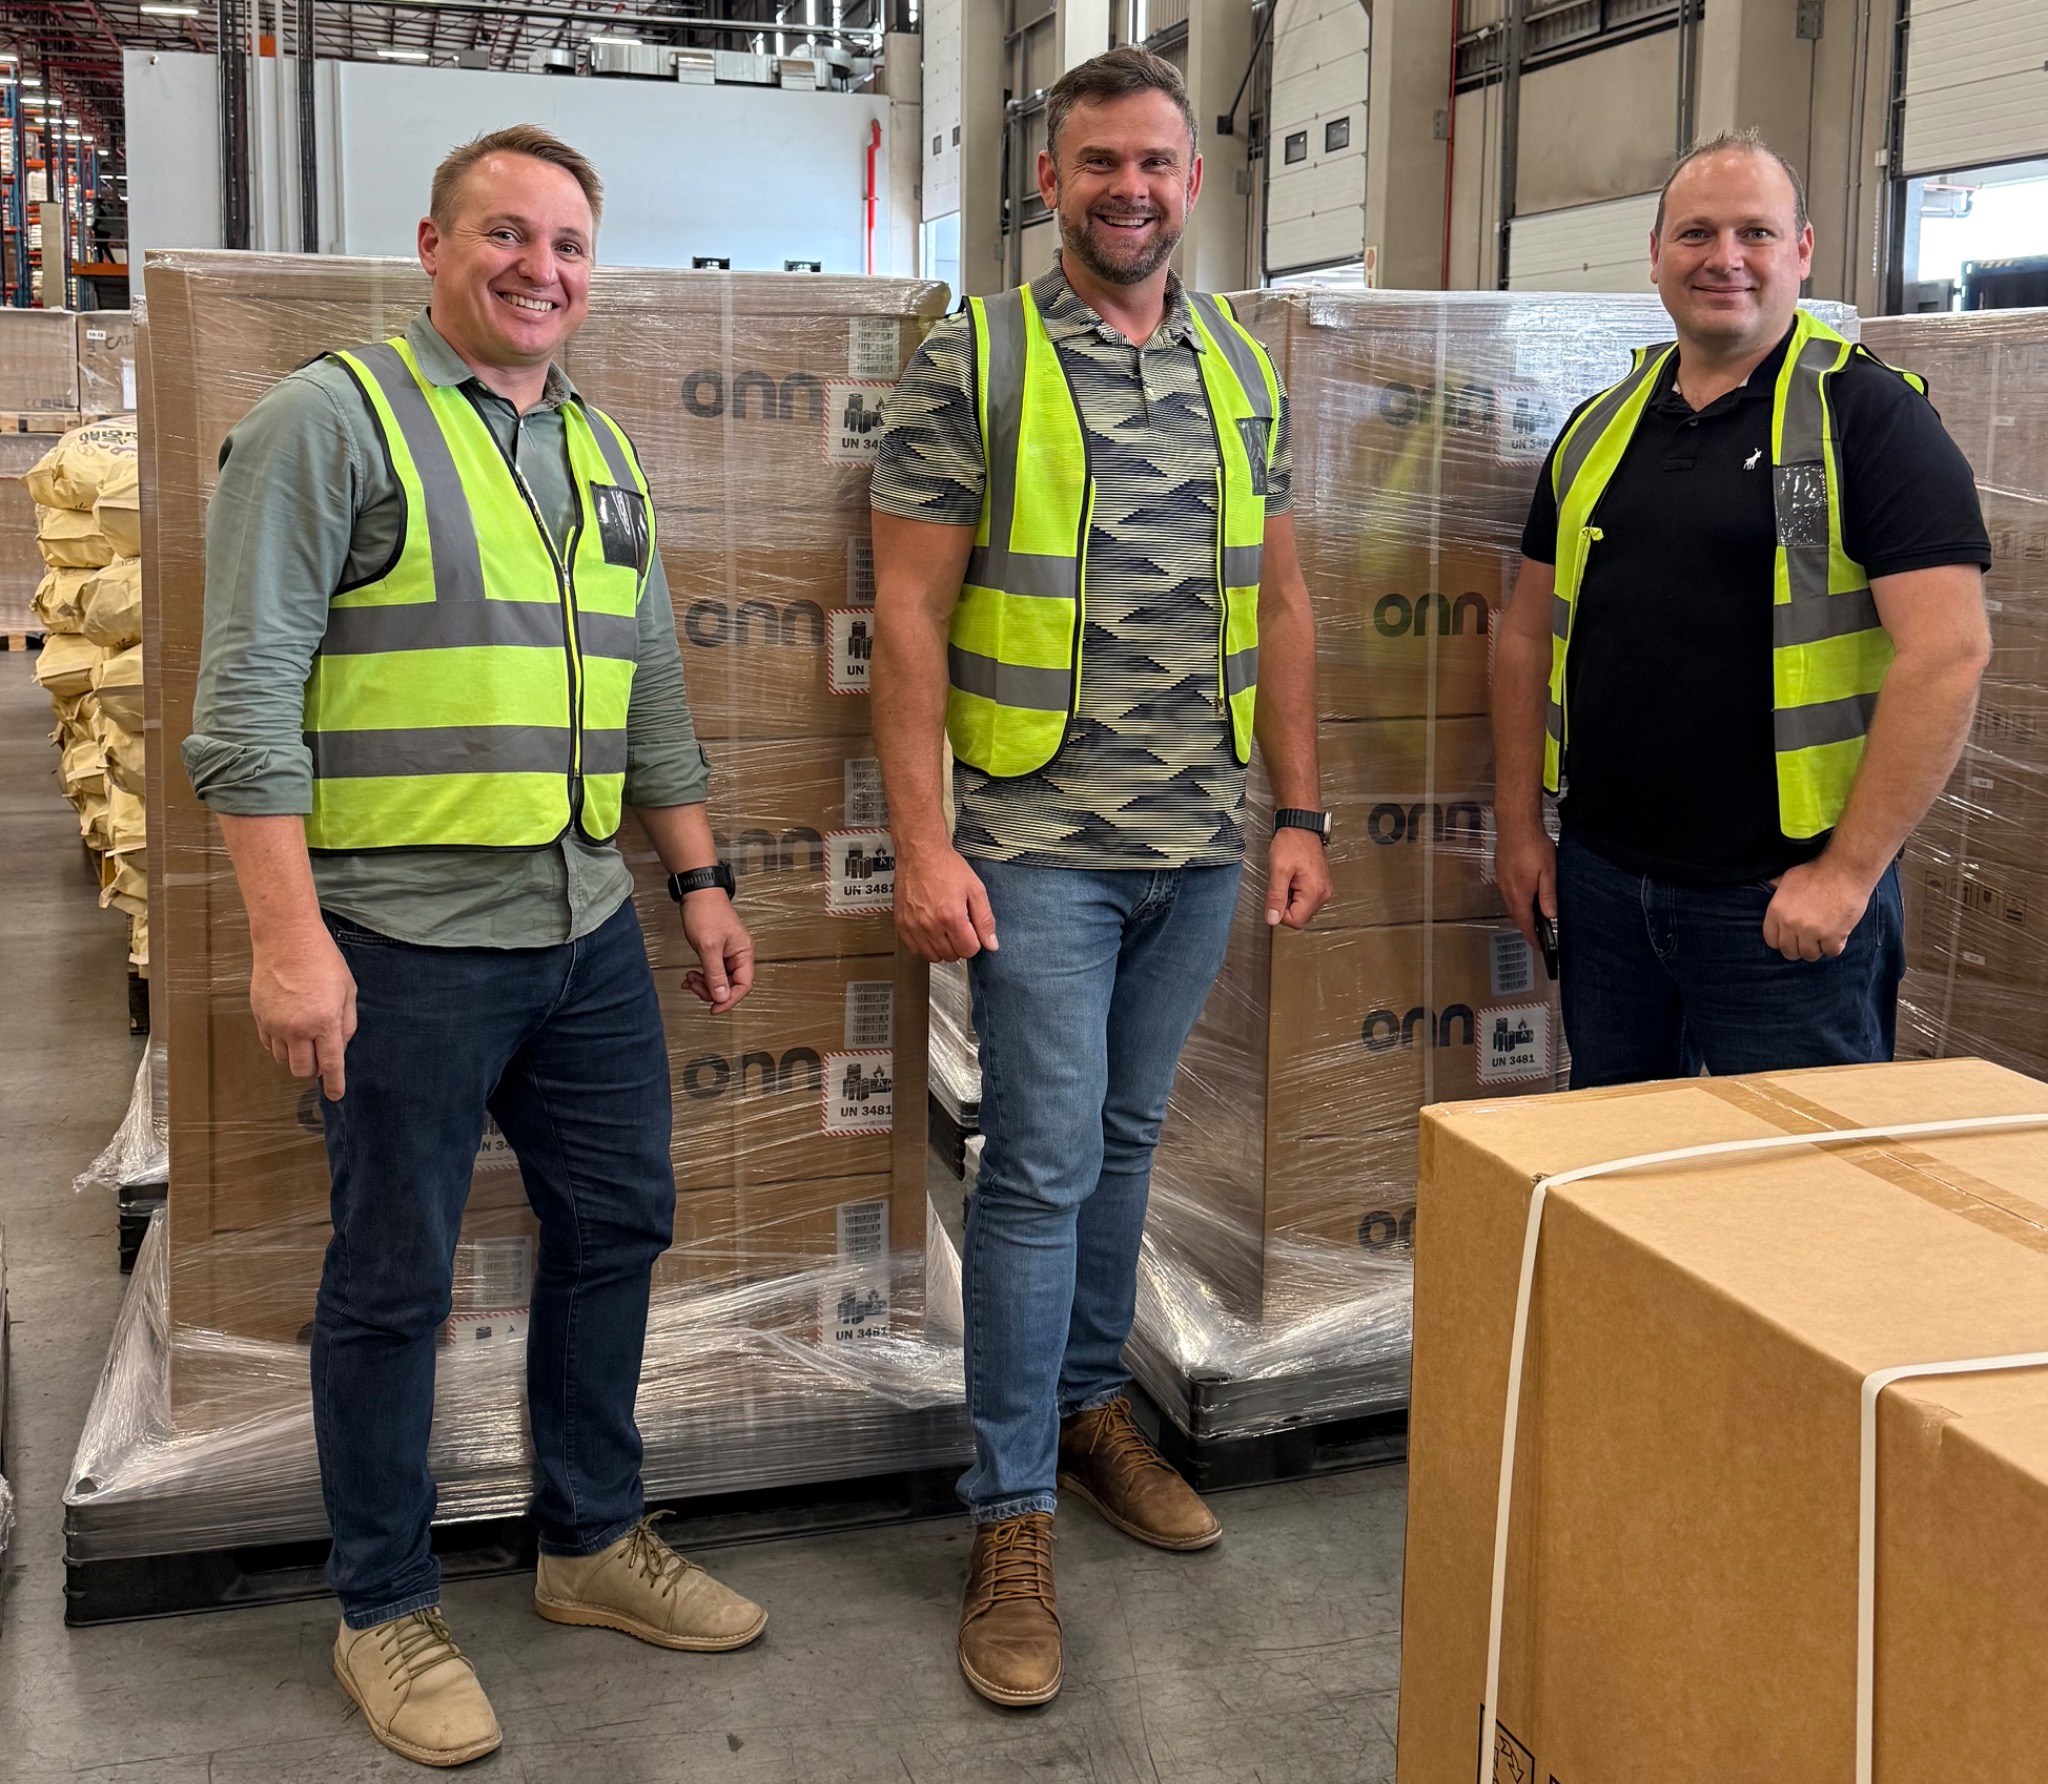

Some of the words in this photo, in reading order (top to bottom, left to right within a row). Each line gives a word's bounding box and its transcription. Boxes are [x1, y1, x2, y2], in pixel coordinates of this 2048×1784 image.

[681, 370, 823, 420] onn
[1379, 381, 1494, 427] onn
[842, 437, 859, 449] UN
[863, 439, 882, 450] 34
[1511, 439, 1526, 449] UN
[684, 599, 825, 648] onn
[1373, 591, 1488, 638] onn
[847, 664, 864, 676] UN
[1367, 802, 1481, 846] onn
[714, 826, 823, 876] nn
[844, 885, 861, 896] UN
[1362, 1003, 1475, 1052] onn
[682, 1046, 822, 1101] onn
[1492, 1057, 1506, 1068] UN
[1509, 1054, 1535, 1066] 3481
[840, 1106, 857, 1117] UN
[862, 1104, 892, 1116] 3481
[836, 1330, 853, 1341] UN
